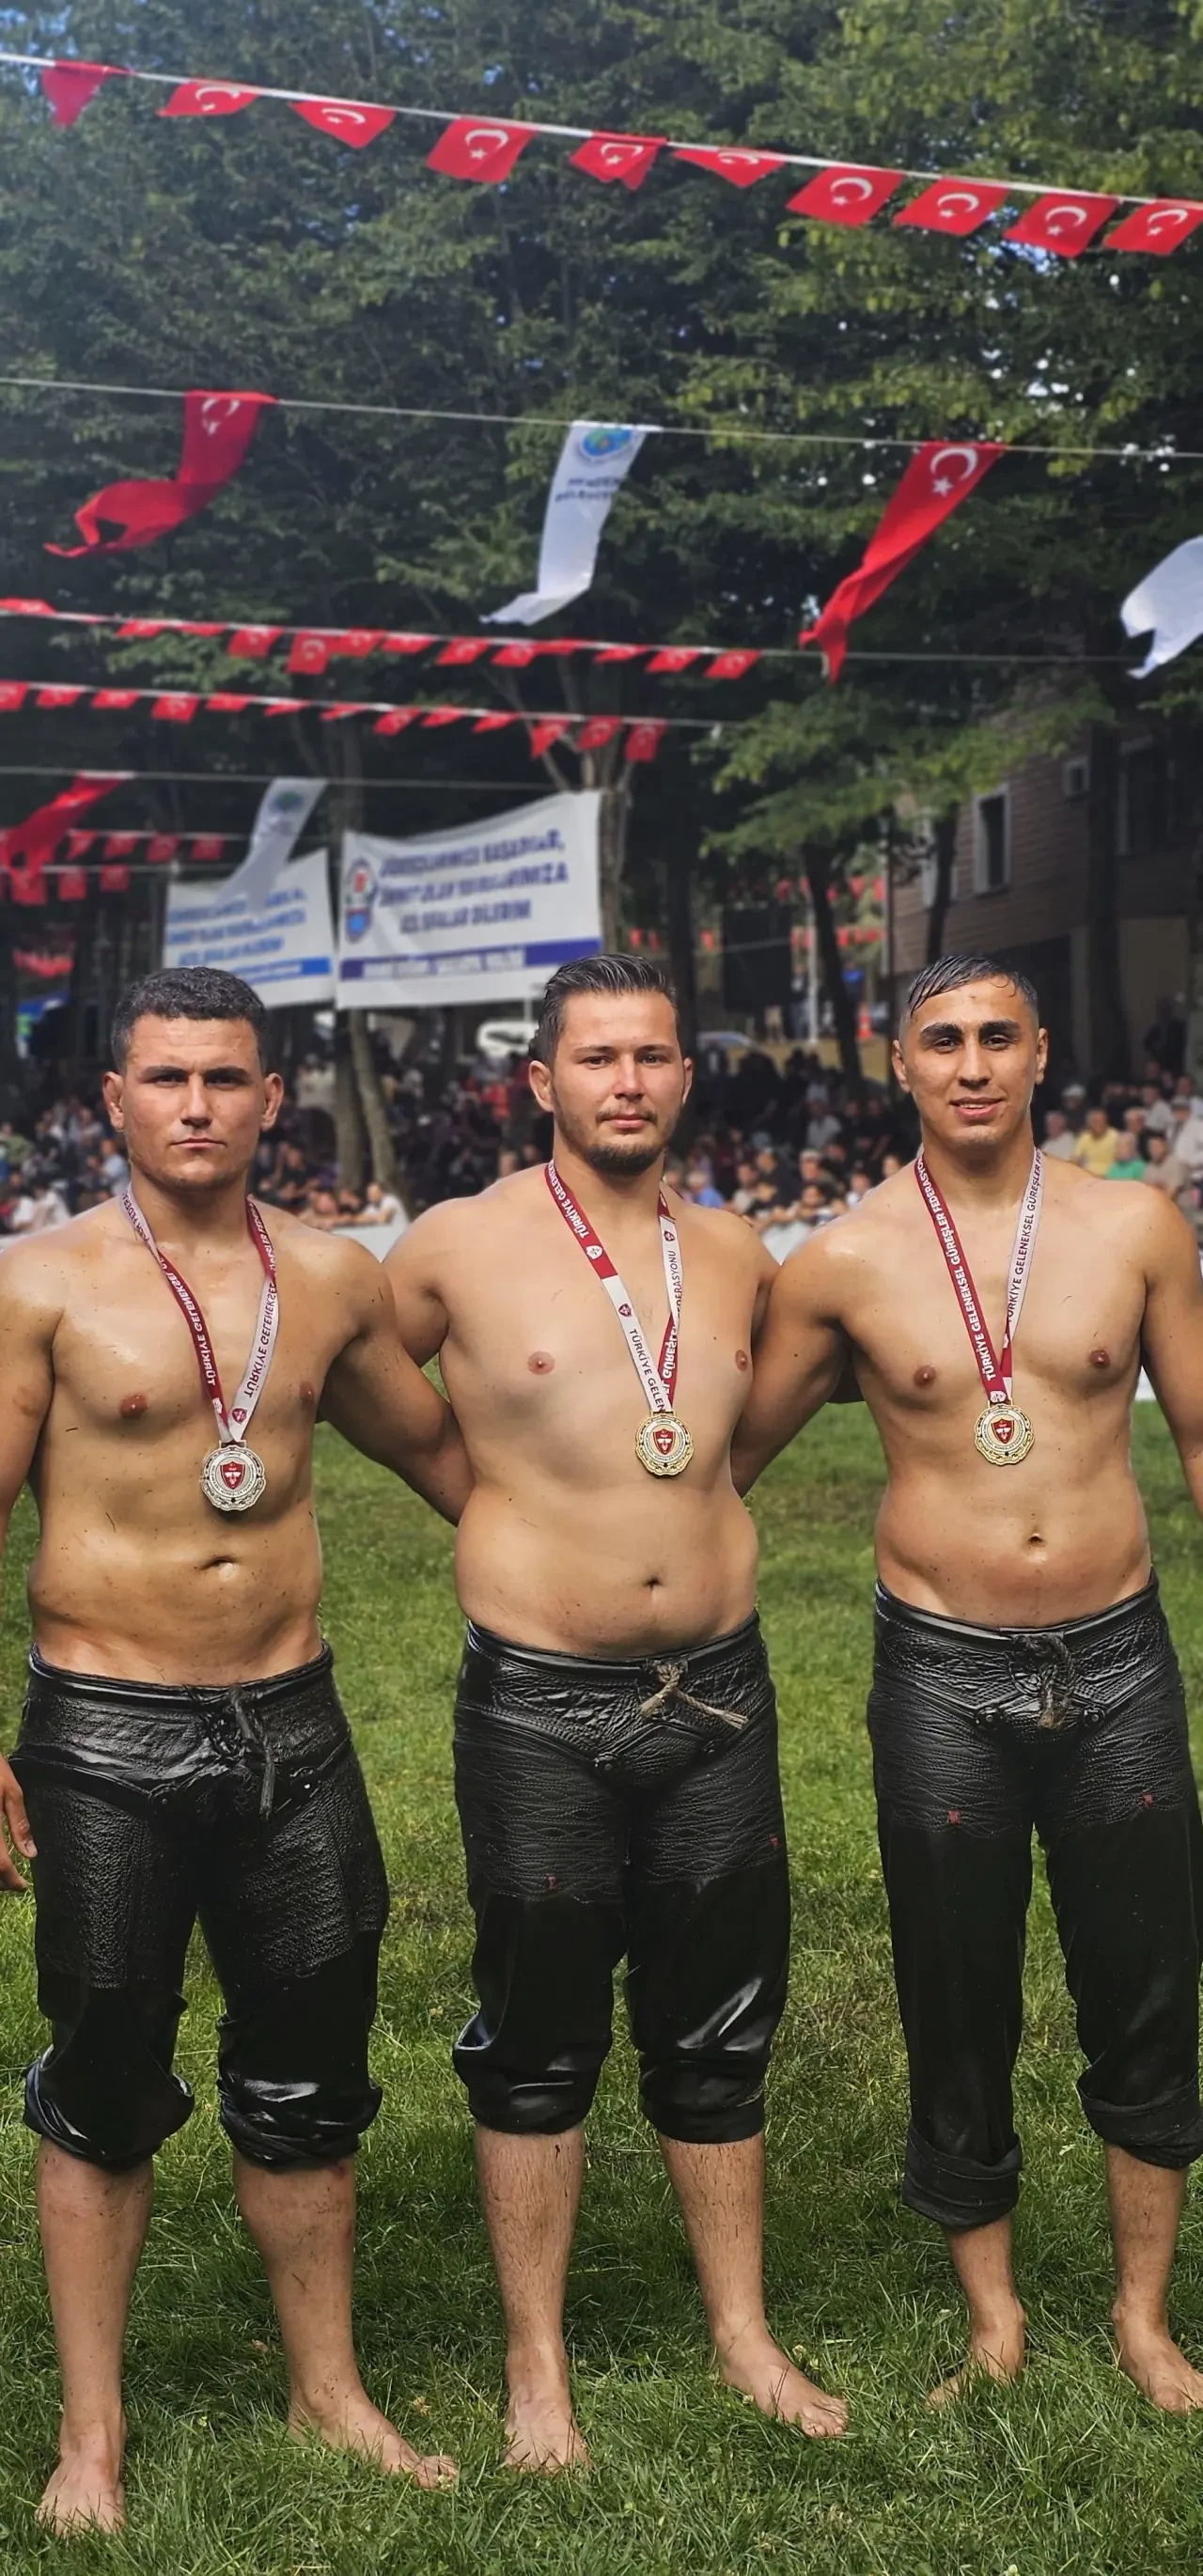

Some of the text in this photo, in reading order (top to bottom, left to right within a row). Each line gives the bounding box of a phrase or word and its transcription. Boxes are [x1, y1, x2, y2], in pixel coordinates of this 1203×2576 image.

[561, 1198, 590, 1239] TÜRKİYE
[935, 1212, 961, 1265] GÜREŞLER
[1014, 1214, 1035, 1274] GELENEKSEL
[1025, 1154, 1041, 1211] GÜREŞLER
[667, 1250, 682, 1319] DERASYONU
[953, 1265, 981, 1332] GELENEKSEL
[629, 1328, 652, 1375] TÜRKİYE
[973, 1333, 996, 1381] TÜRKİYE
